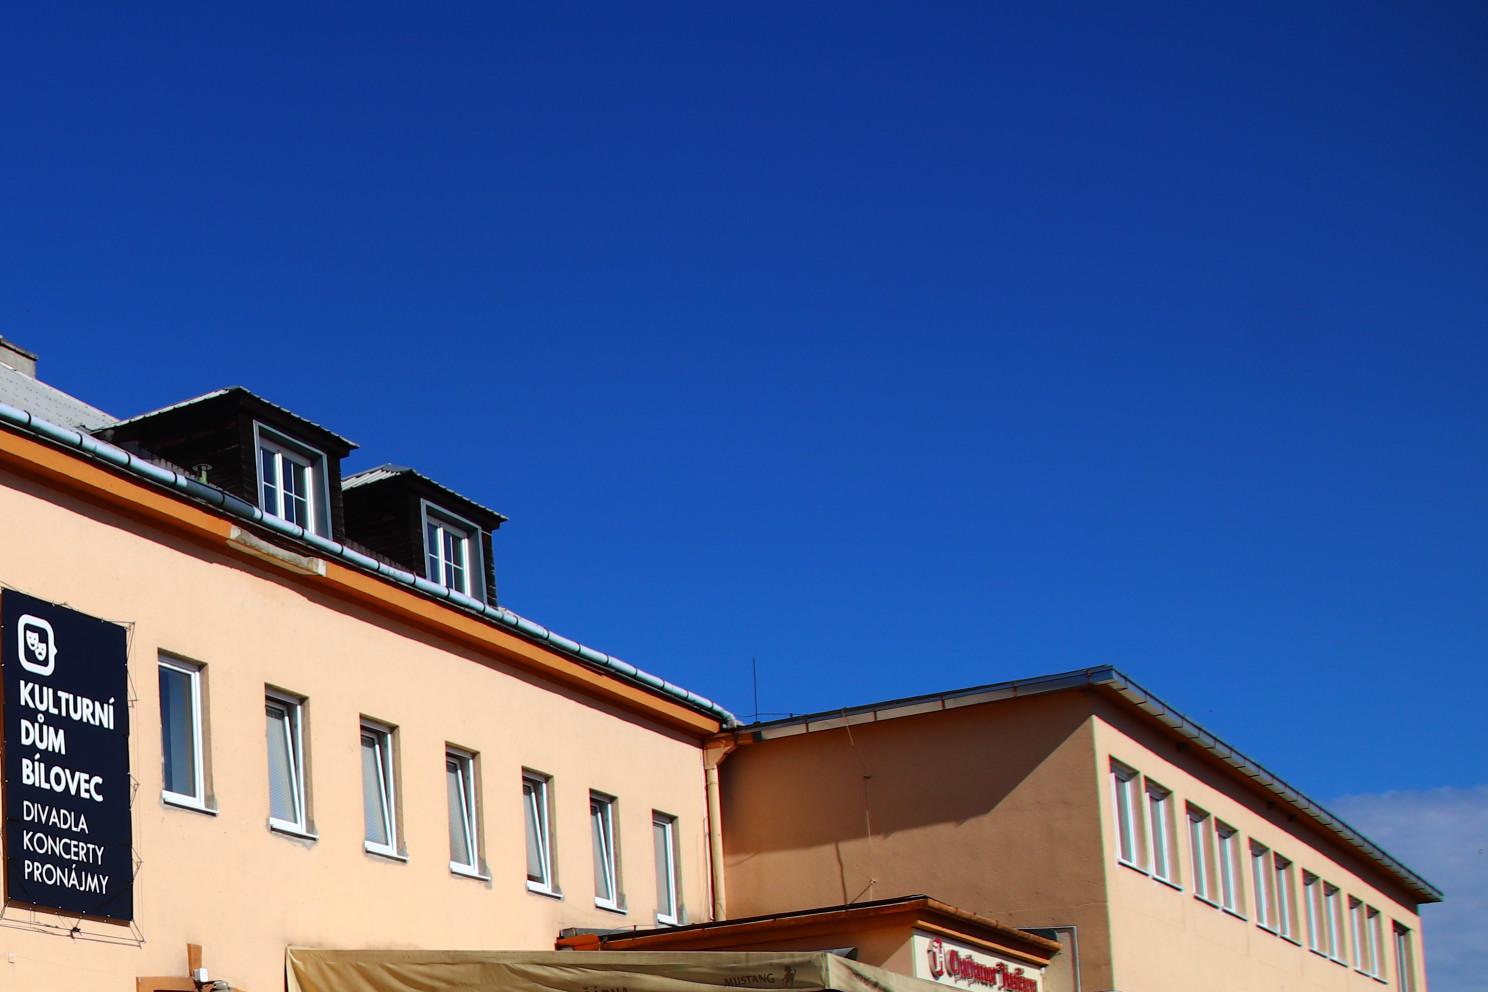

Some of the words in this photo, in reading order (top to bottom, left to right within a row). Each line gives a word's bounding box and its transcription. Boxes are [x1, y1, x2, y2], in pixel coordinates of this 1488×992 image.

[19, 680, 114, 730] KULTURNÍ
[20, 712, 66, 755] DŮM
[21, 754, 104, 801] BÍLOVEC
[23, 800, 89, 834] DIVADLA
[23, 830, 105, 865] KONCERTY
[24, 859, 109, 894] PRONÁJMY
[724, 973, 775, 987] MUSTANG
